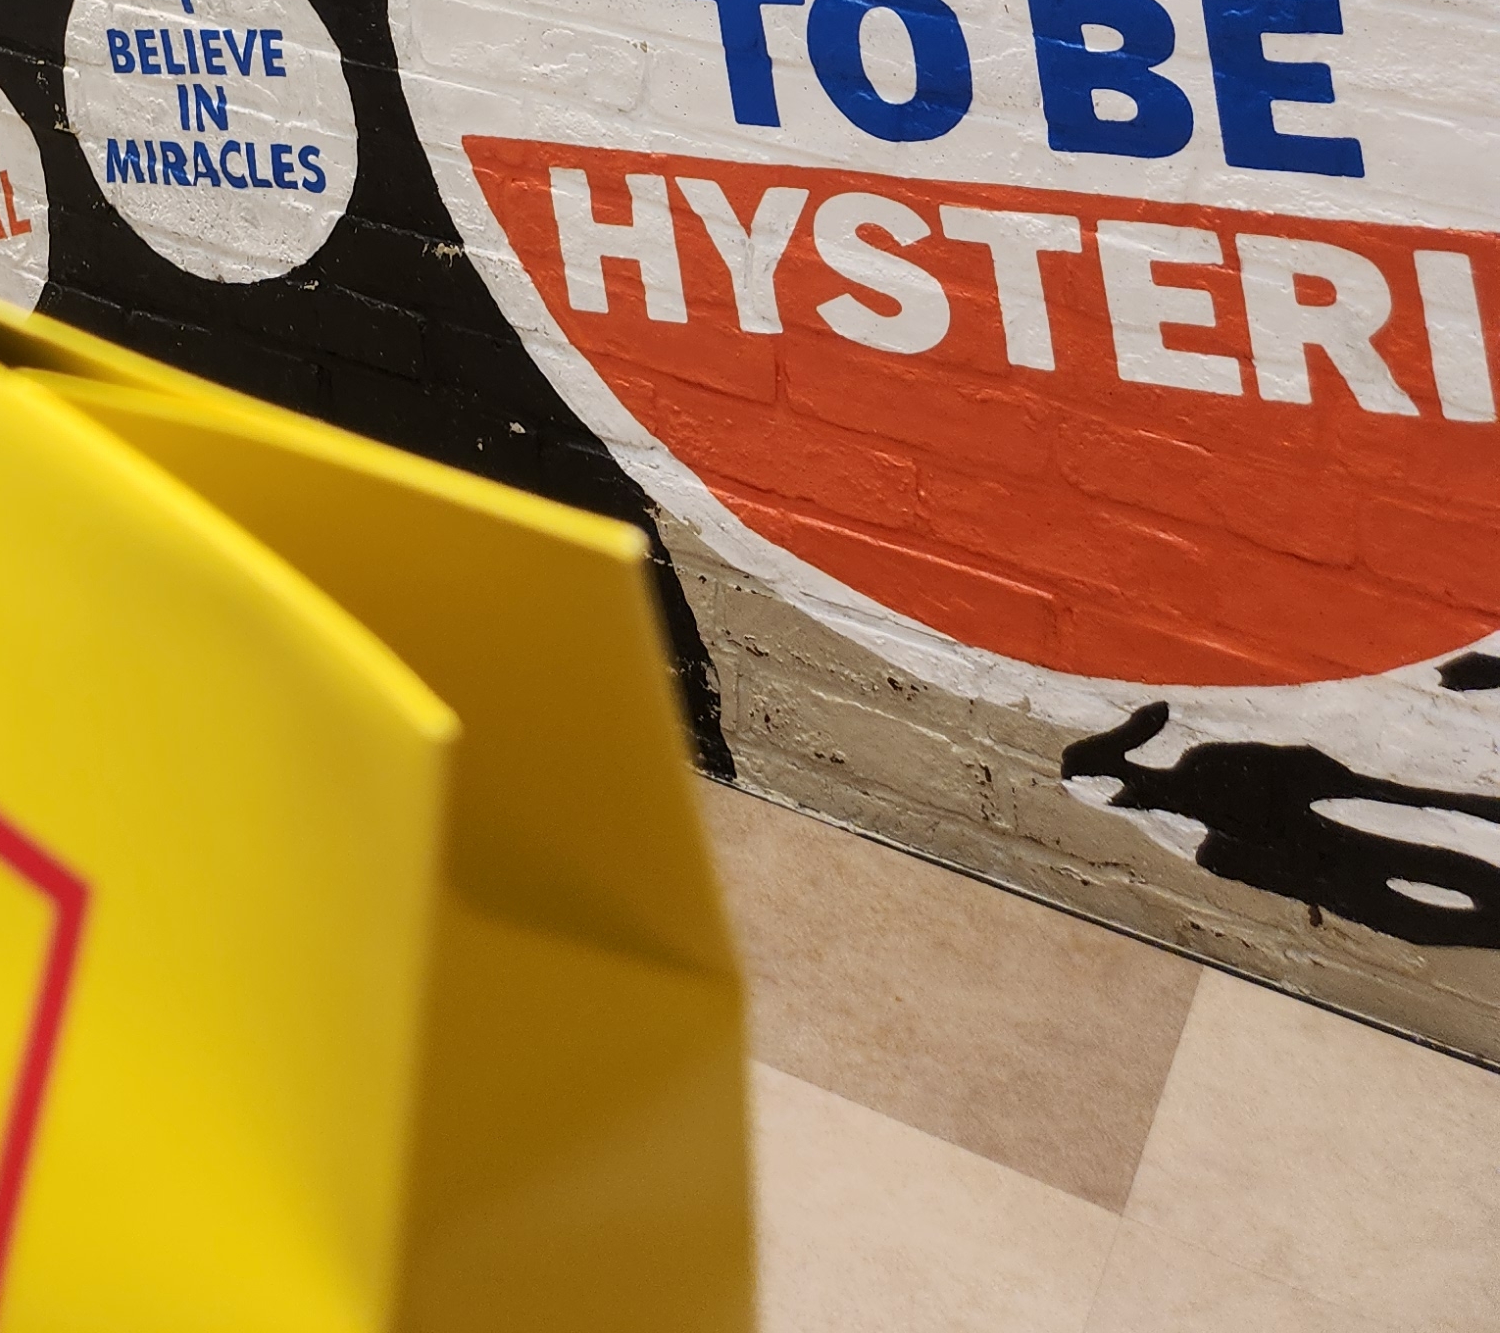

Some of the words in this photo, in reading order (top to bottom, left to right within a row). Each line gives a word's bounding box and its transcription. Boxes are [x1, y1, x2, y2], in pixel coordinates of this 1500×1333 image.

[106, 27, 288, 78] BELIEVE
[176, 83, 229, 133] IN
[105, 137, 328, 194] MIRACLES
